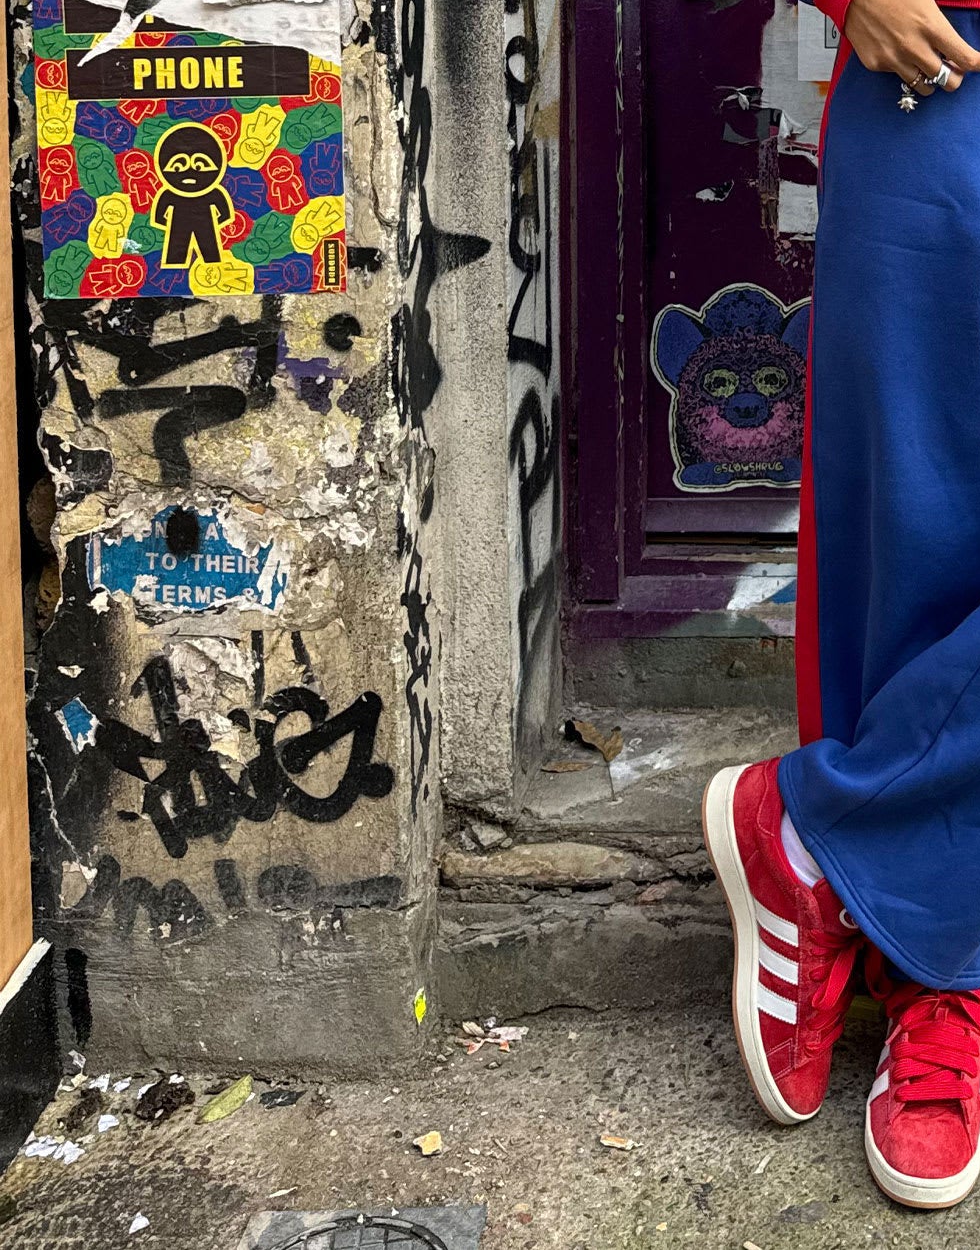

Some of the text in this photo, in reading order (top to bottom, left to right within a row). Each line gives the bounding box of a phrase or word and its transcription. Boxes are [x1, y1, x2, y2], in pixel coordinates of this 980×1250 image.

[133, 56, 244, 90] PHONE
[145, 552, 261, 575] TO THEIR
[149, 583, 227, 605] TERMS
